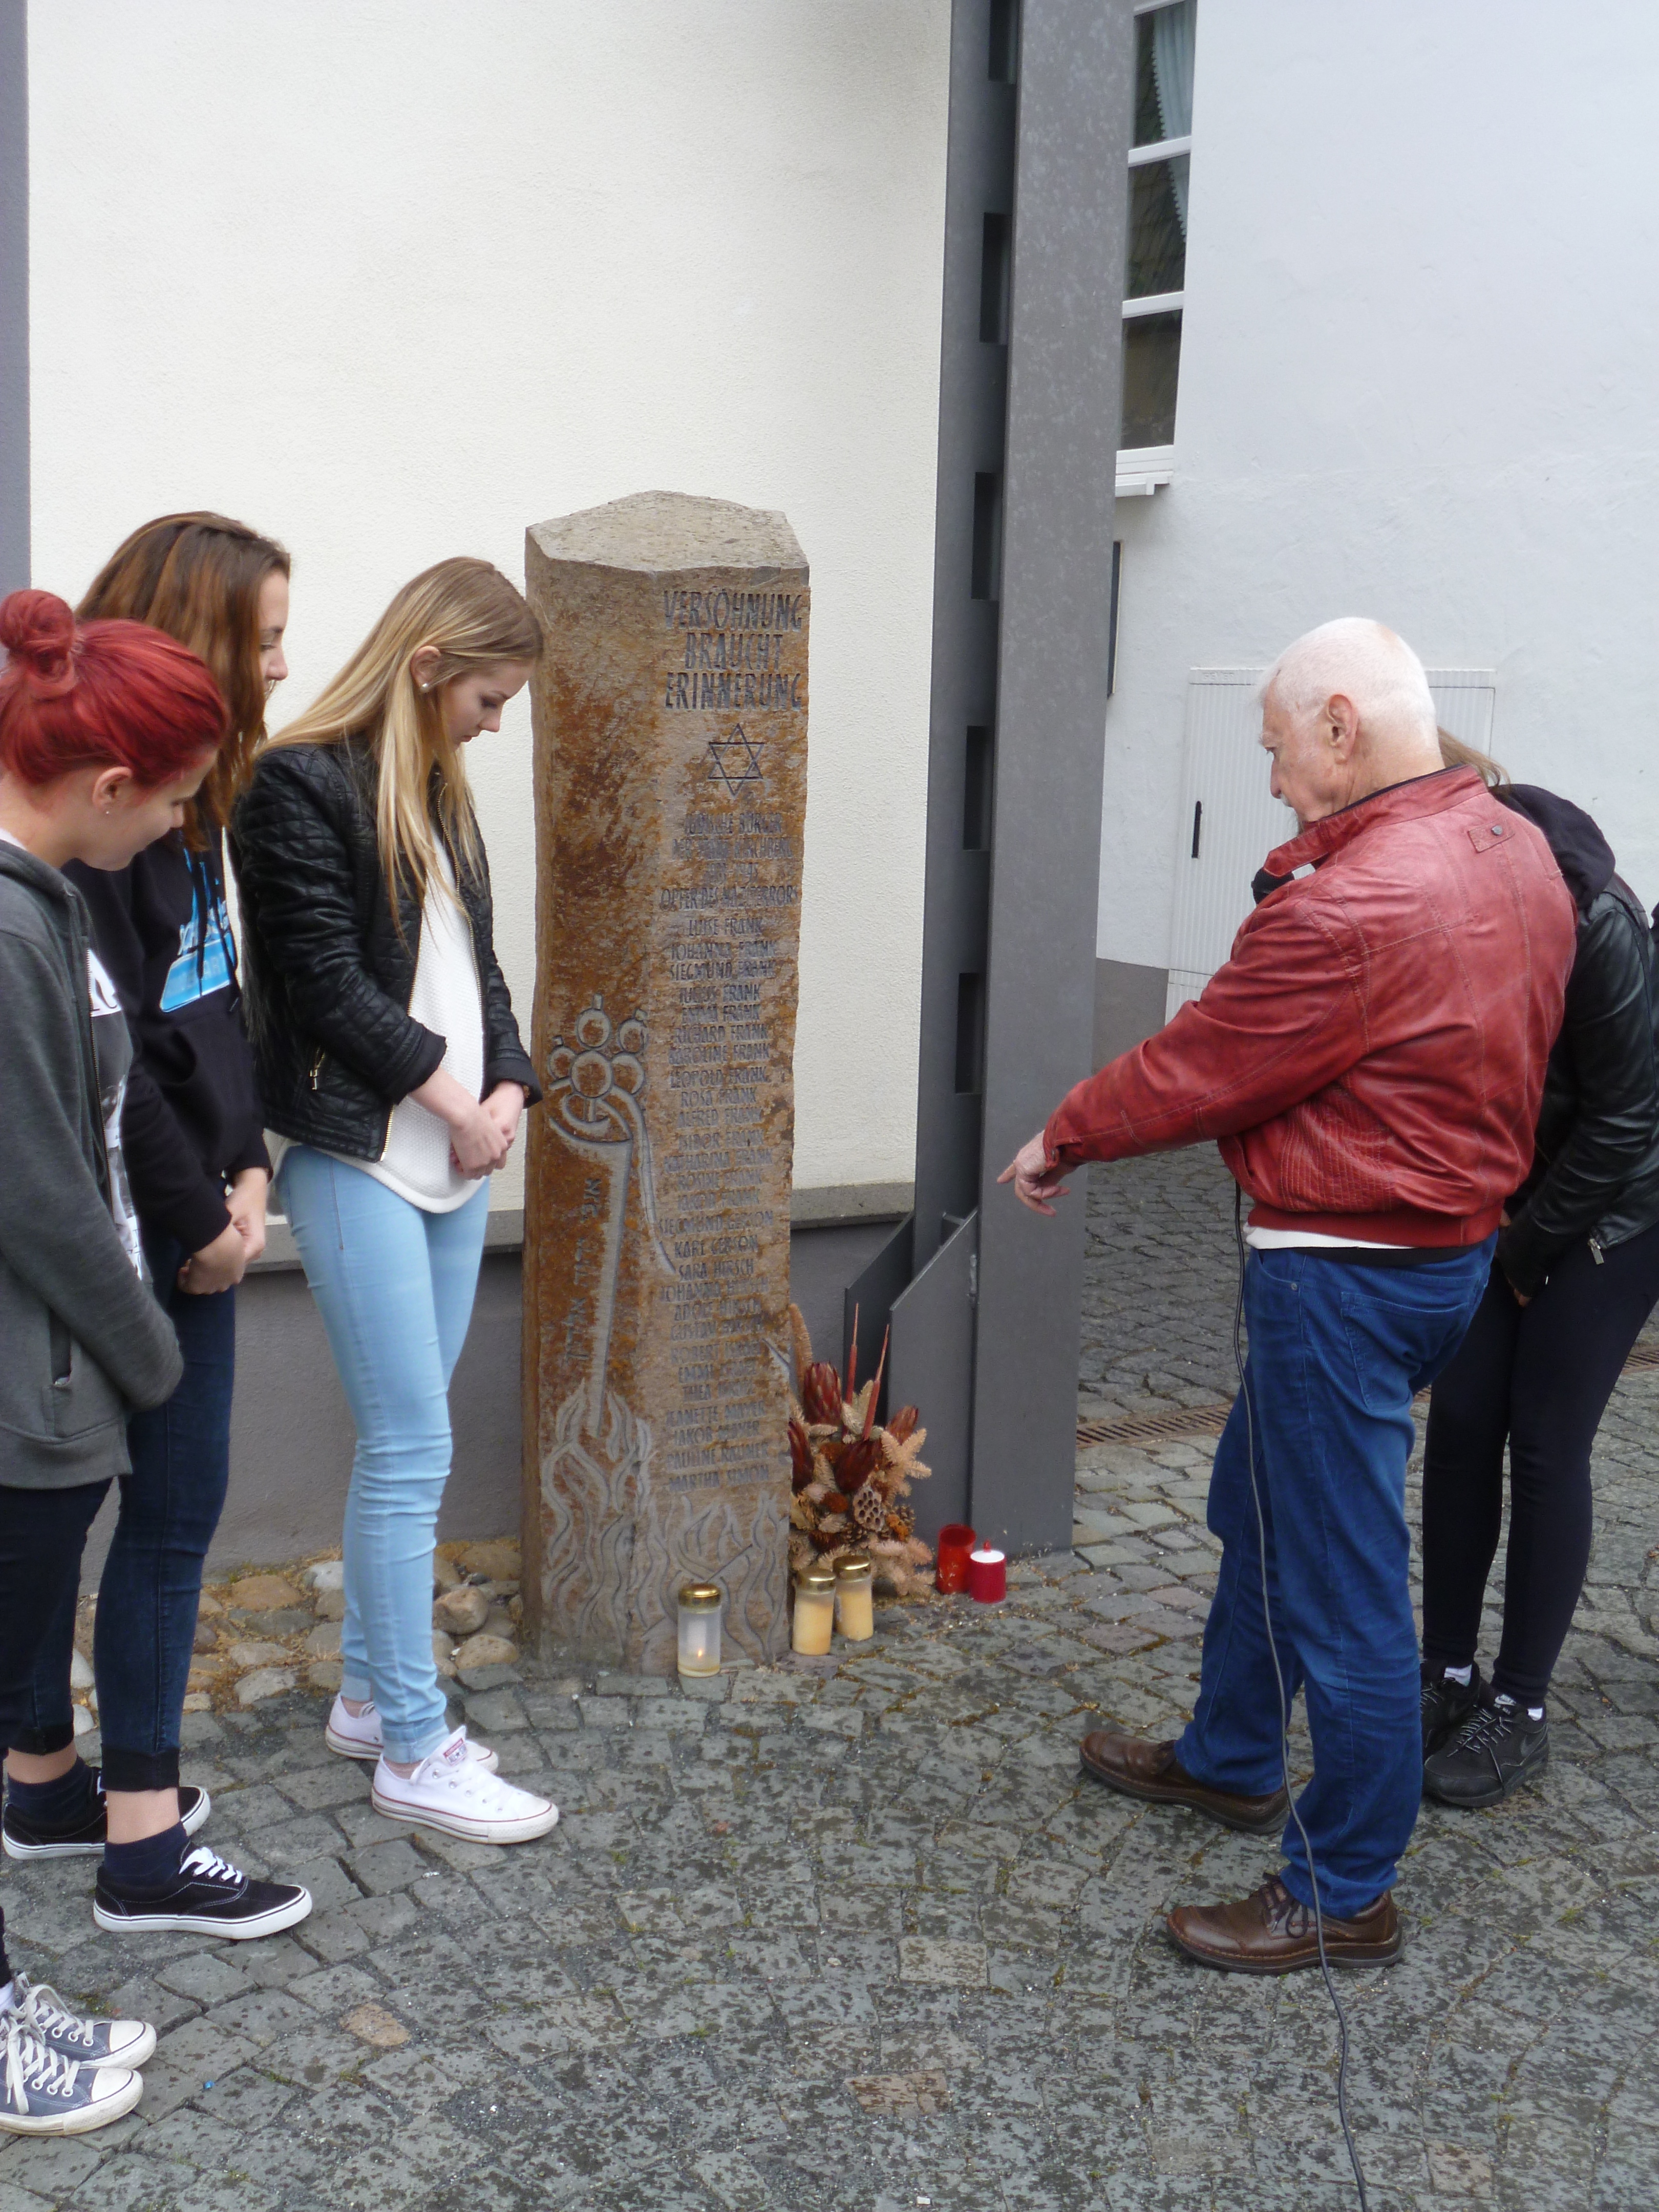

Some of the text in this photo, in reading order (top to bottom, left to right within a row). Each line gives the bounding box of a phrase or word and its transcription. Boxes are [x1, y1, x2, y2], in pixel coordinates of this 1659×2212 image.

[685, 632, 783, 671] BRAUCHT
[665, 672, 802, 710] ERINNERUNG
[660, 888, 698, 910] OPFER
[701, 886, 719, 909] DES
[724, 917, 763, 935] FRANK
[669, 959, 777, 981] SIEGMUND FRANK
[722, 984, 761, 1003] FRANK
[722, 1004, 761, 1022] FRANK
[730, 1023, 770, 1041] FRANK
[733, 1043, 771, 1060] FRANK
[670, 1066, 770, 1089] LEOPOLD FRANK
[680, 1087, 757, 1108] ROSA FRANK
[676, 1109, 719, 1129] ALFRED
[674, 1240, 706, 1259] KARL
[678, 1258, 755, 1282] SARA HIRSCH
[660, 1282, 721, 1303] JOHANNA
[670, 1343, 720, 1365] ROBERT
[673, 1426, 714, 1446] JAKOB
[667, 1449, 716, 1472] PAULINE
